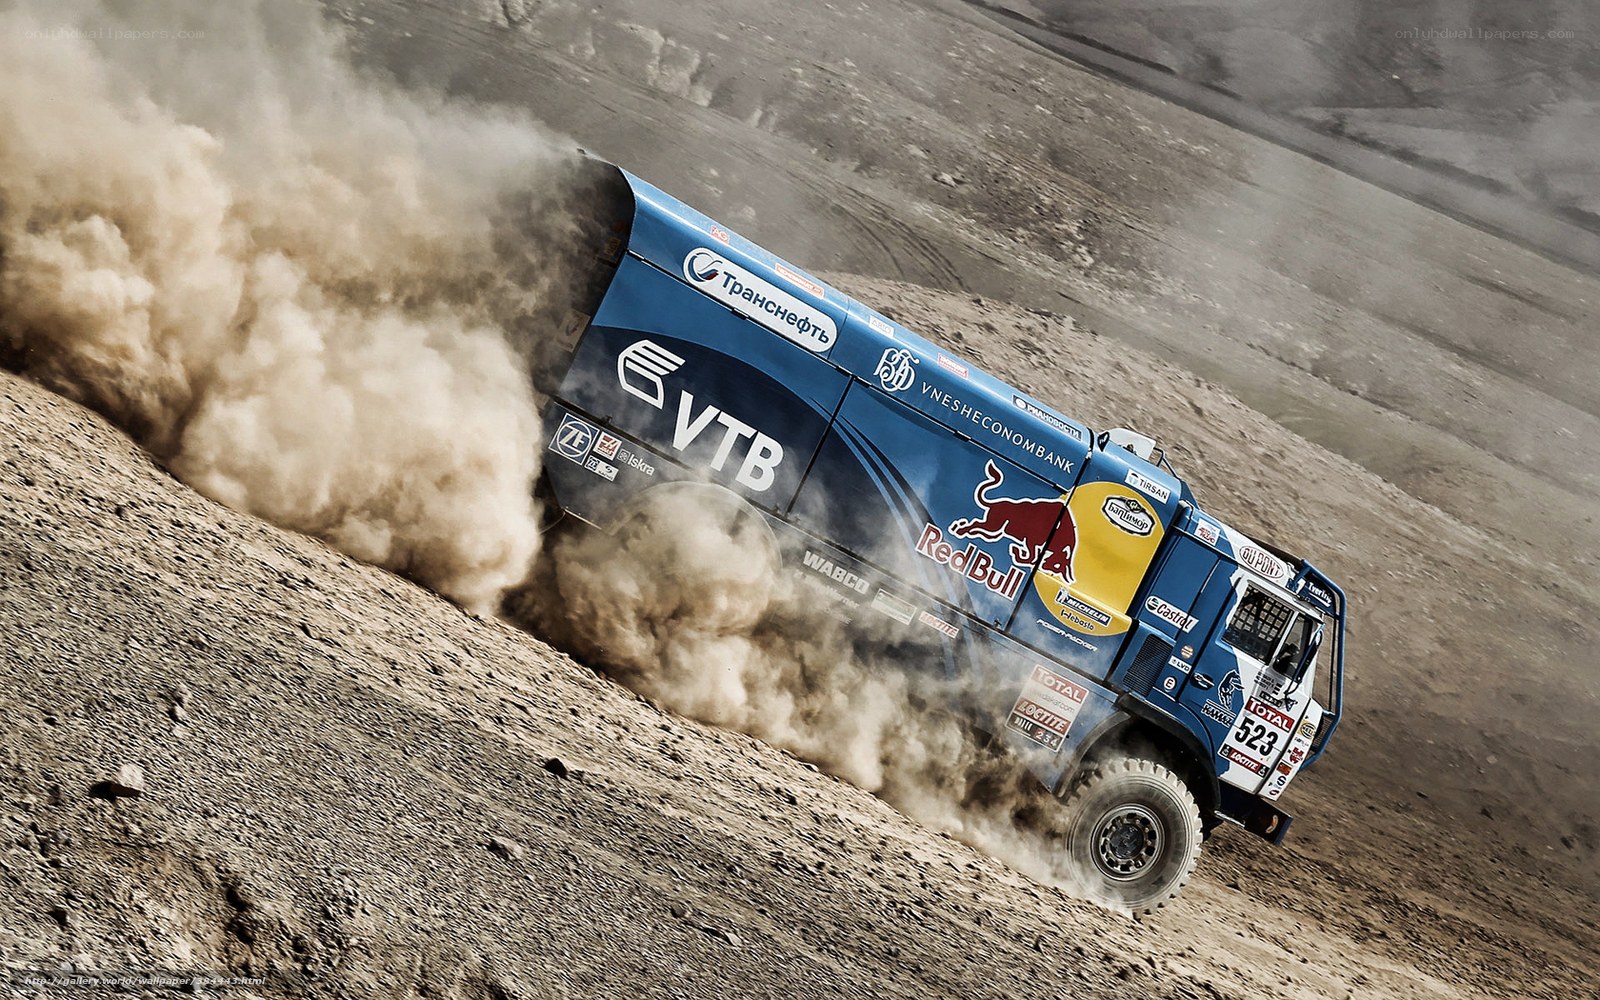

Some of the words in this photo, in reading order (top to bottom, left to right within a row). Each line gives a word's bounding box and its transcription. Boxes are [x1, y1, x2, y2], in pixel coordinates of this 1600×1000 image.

[720, 270, 830, 345] Транснефть
[557, 425, 588, 454] ZF
[672, 389, 785, 492] VTB
[921, 381, 1075, 474] VNESHECONOMBANK
[628, 453, 655, 476] Iskra
[803, 551, 871, 595] WABCO
[1066, 597, 1110, 624] MICHELIN
[1156, 603, 1194, 630] Castrol
[1036, 667, 1082, 702] TOTAL
[1018, 701, 1068, 732] LOCTITE
[1250, 700, 1294, 732] TOTAL
[1234, 716, 1279, 757] 523
[1230, 751, 1260, 771] LOCTITE
